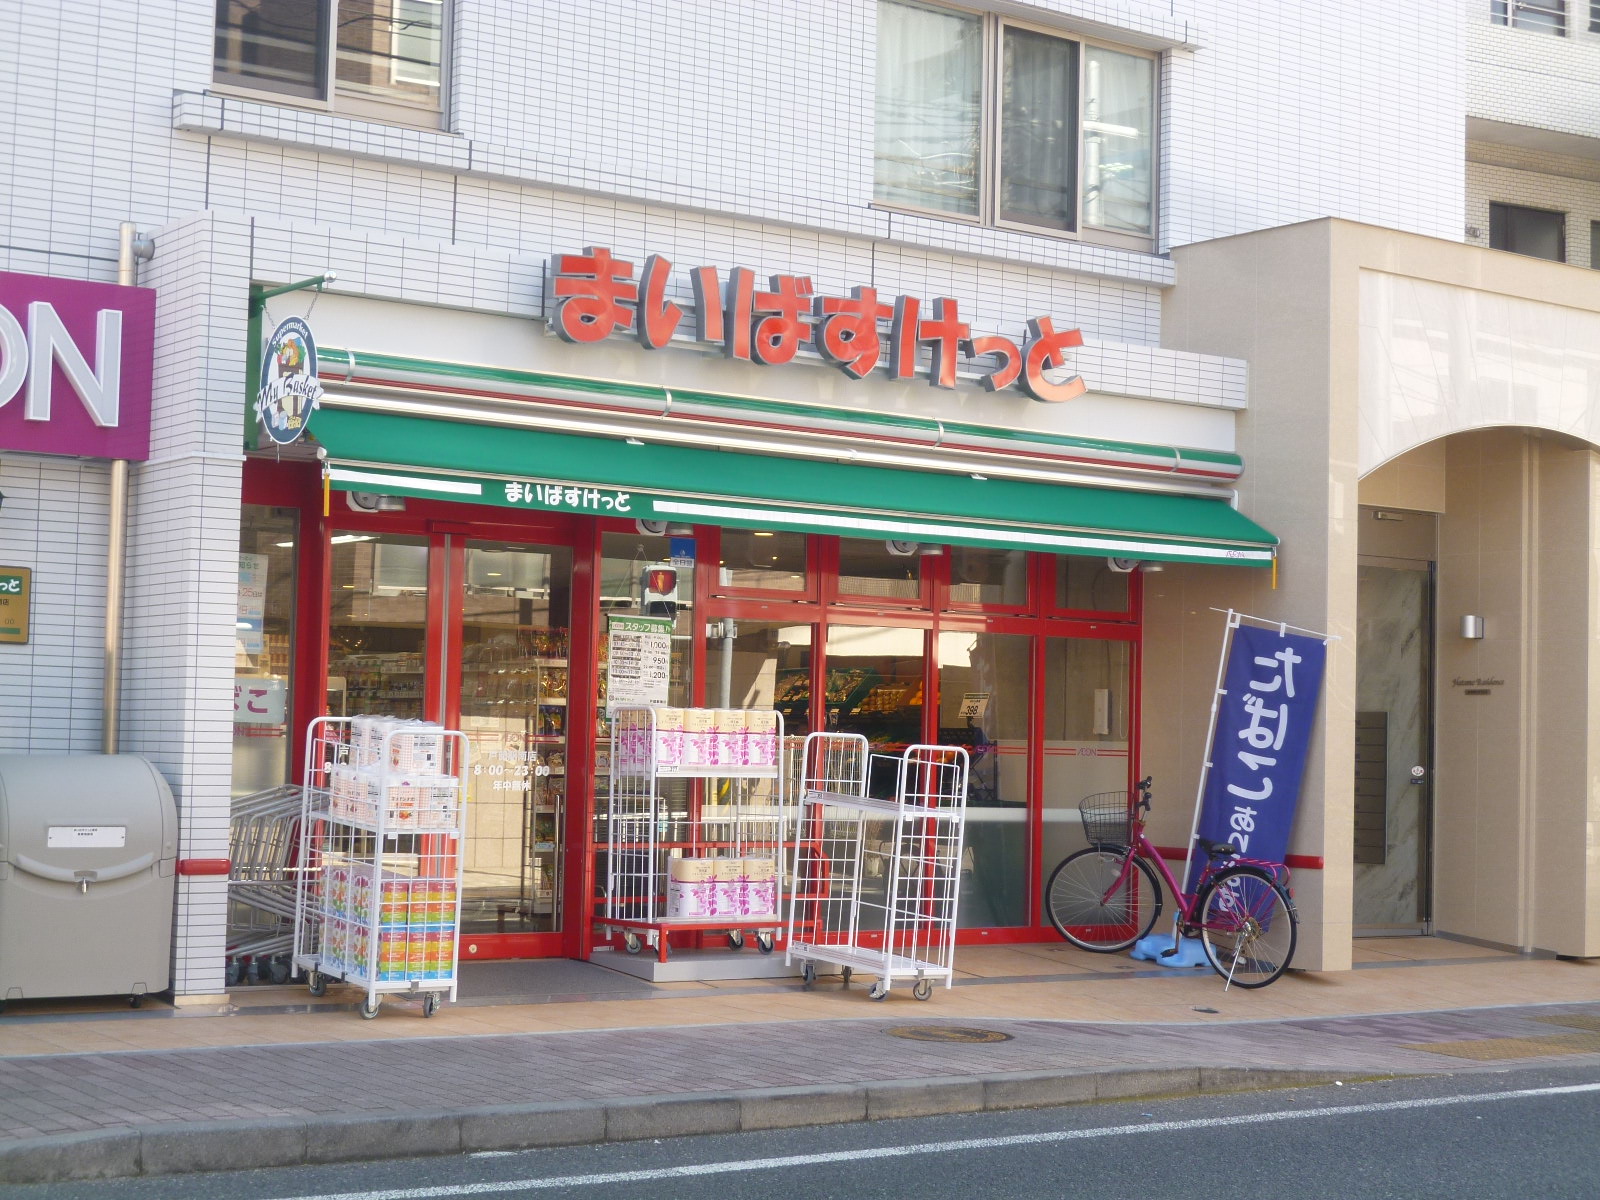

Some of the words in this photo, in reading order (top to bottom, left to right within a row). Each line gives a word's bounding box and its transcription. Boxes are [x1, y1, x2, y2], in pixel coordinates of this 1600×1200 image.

[271, 321, 308, 347] Supermarket
[546, 246, 1087, 403] まいばすけっと
[257, 382, 279, 411] My
[283, 372, 317, 400] Basket
[504, 481, 632, 512] まいばすけっと
